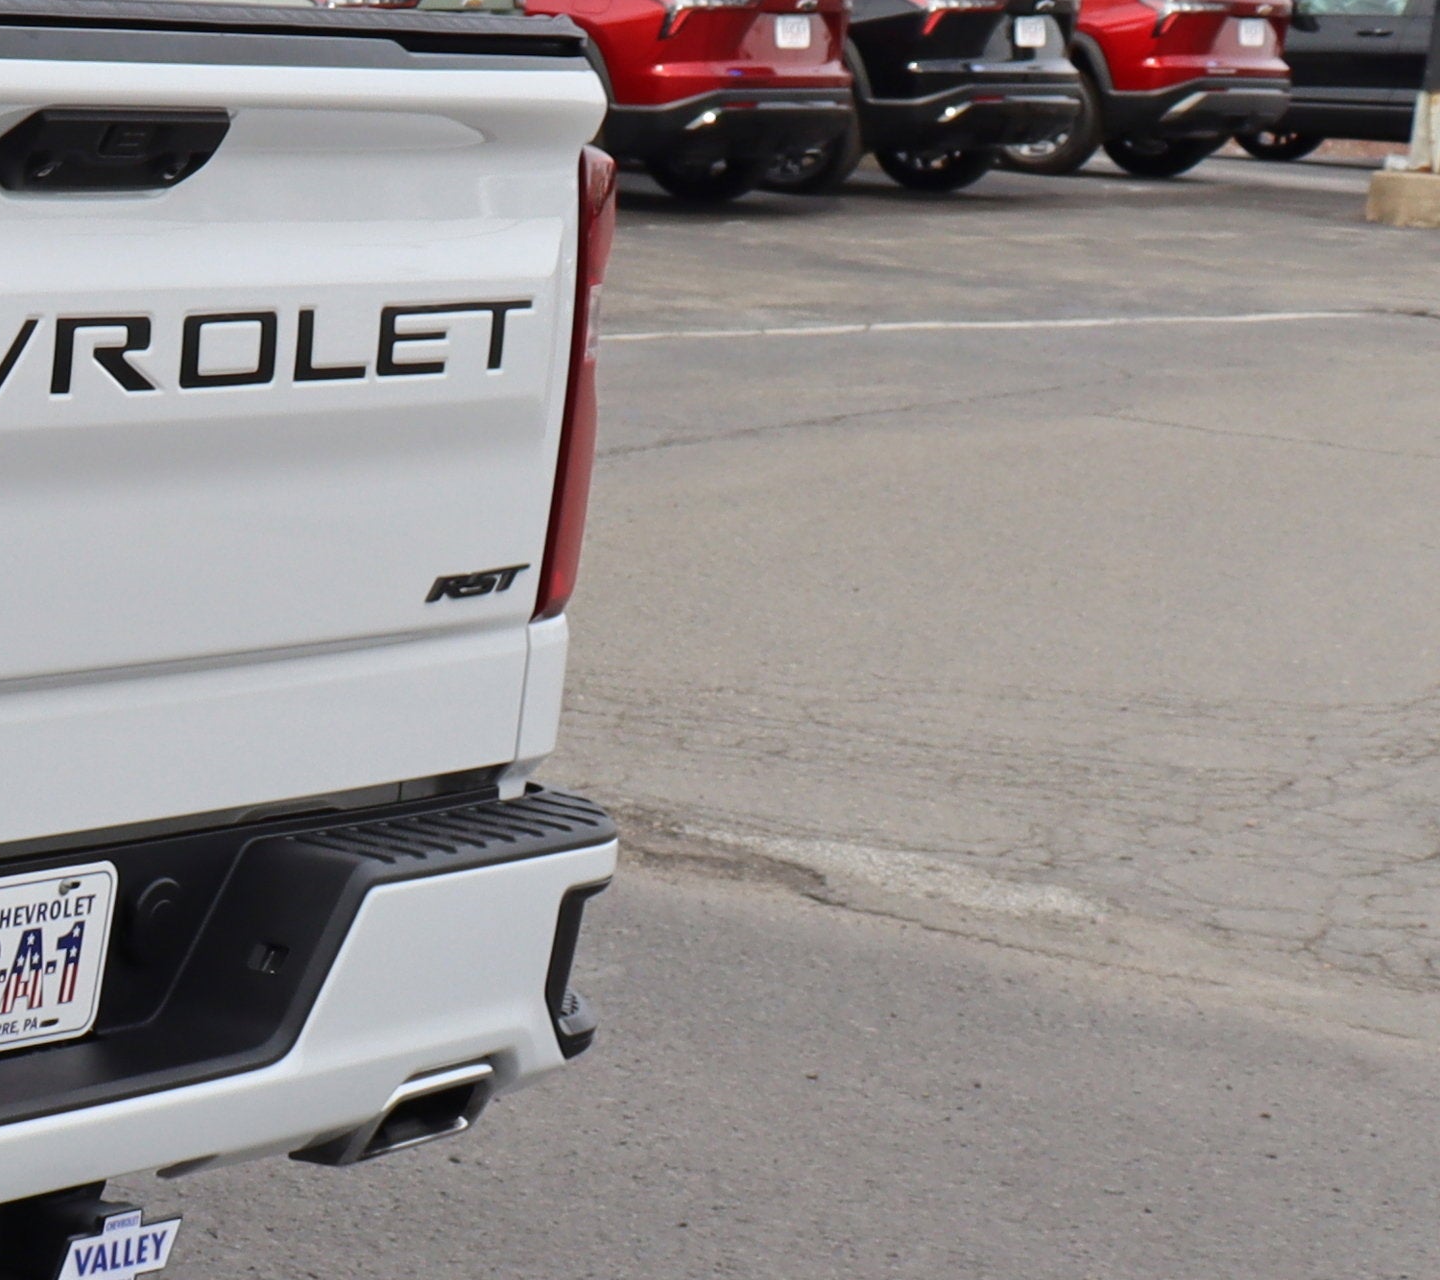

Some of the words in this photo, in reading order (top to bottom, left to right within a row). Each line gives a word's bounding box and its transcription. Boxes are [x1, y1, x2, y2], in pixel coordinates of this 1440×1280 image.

[424, 563, 531, 603] RST
[23, 1017, 38, 1032] PA
[74, 1230, 168, 1277] VALLEY
